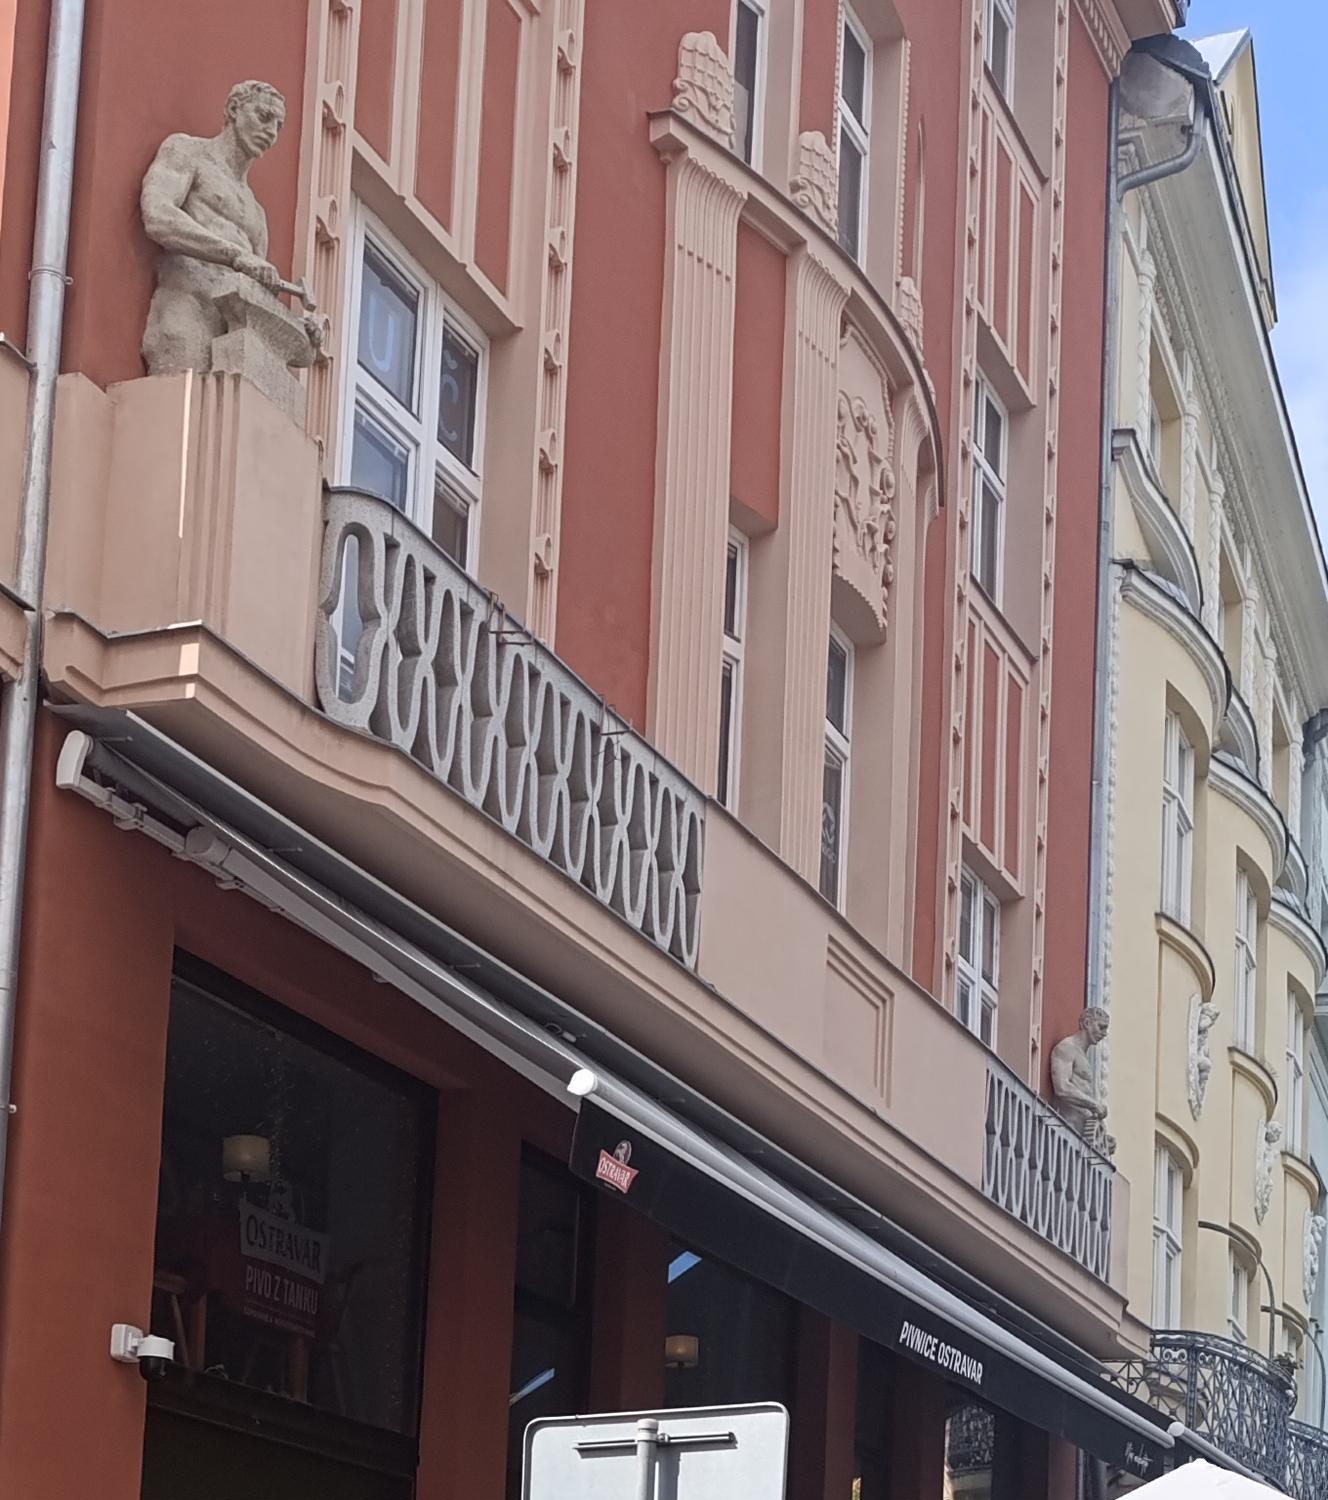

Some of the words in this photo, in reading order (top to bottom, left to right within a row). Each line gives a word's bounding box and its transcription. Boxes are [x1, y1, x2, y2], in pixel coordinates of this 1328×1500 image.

[598, 1157, 631, 1189] OSTRAVAR
[246, 1214, 321, 1273] OSTRAVAR
[245, 1264, 271, 1299] PIVO
[283, 1278, 319, 1315] TANKU
[899, 1320, 937, 1361] PIVNICE
[937, 1342, 984, 1385] OSTRAVAR
